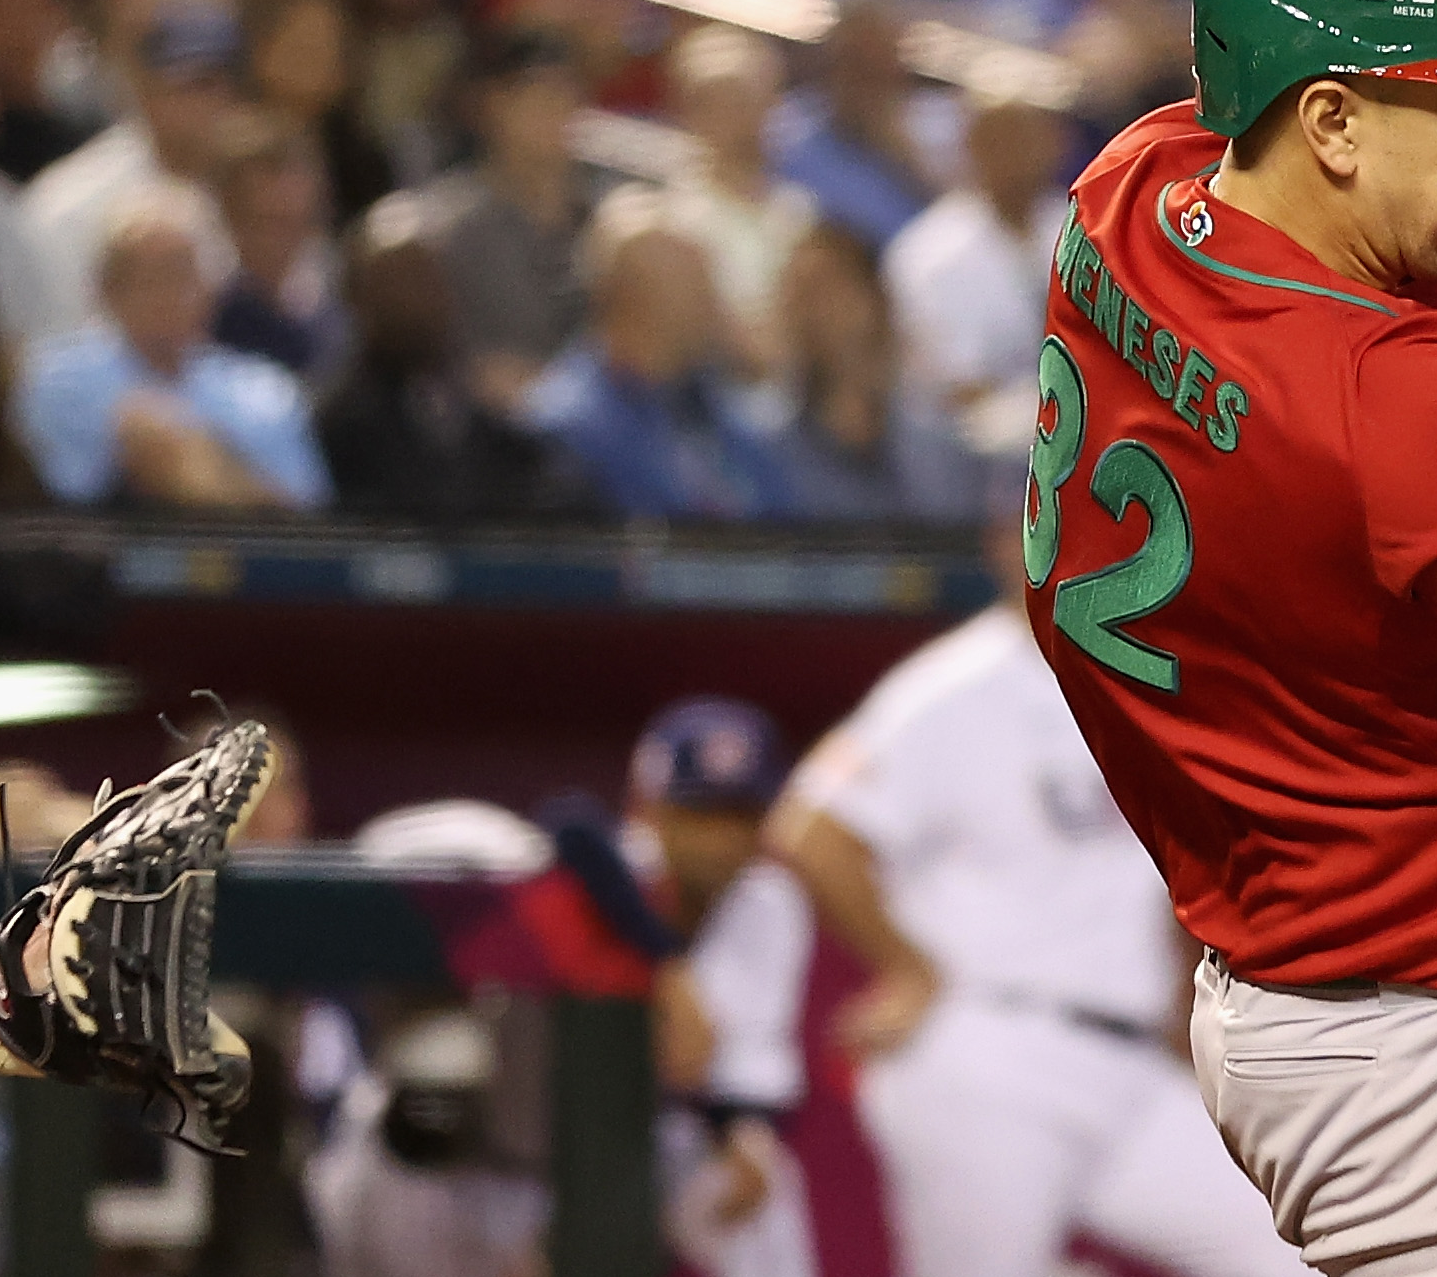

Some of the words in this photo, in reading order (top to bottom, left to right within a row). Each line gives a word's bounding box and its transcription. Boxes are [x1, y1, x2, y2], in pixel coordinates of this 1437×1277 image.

[1393, 5, 1435, 18] METALS
[1055, 194, 1250, 453] MENESES
[1023, 334, 1195, 694] 32
